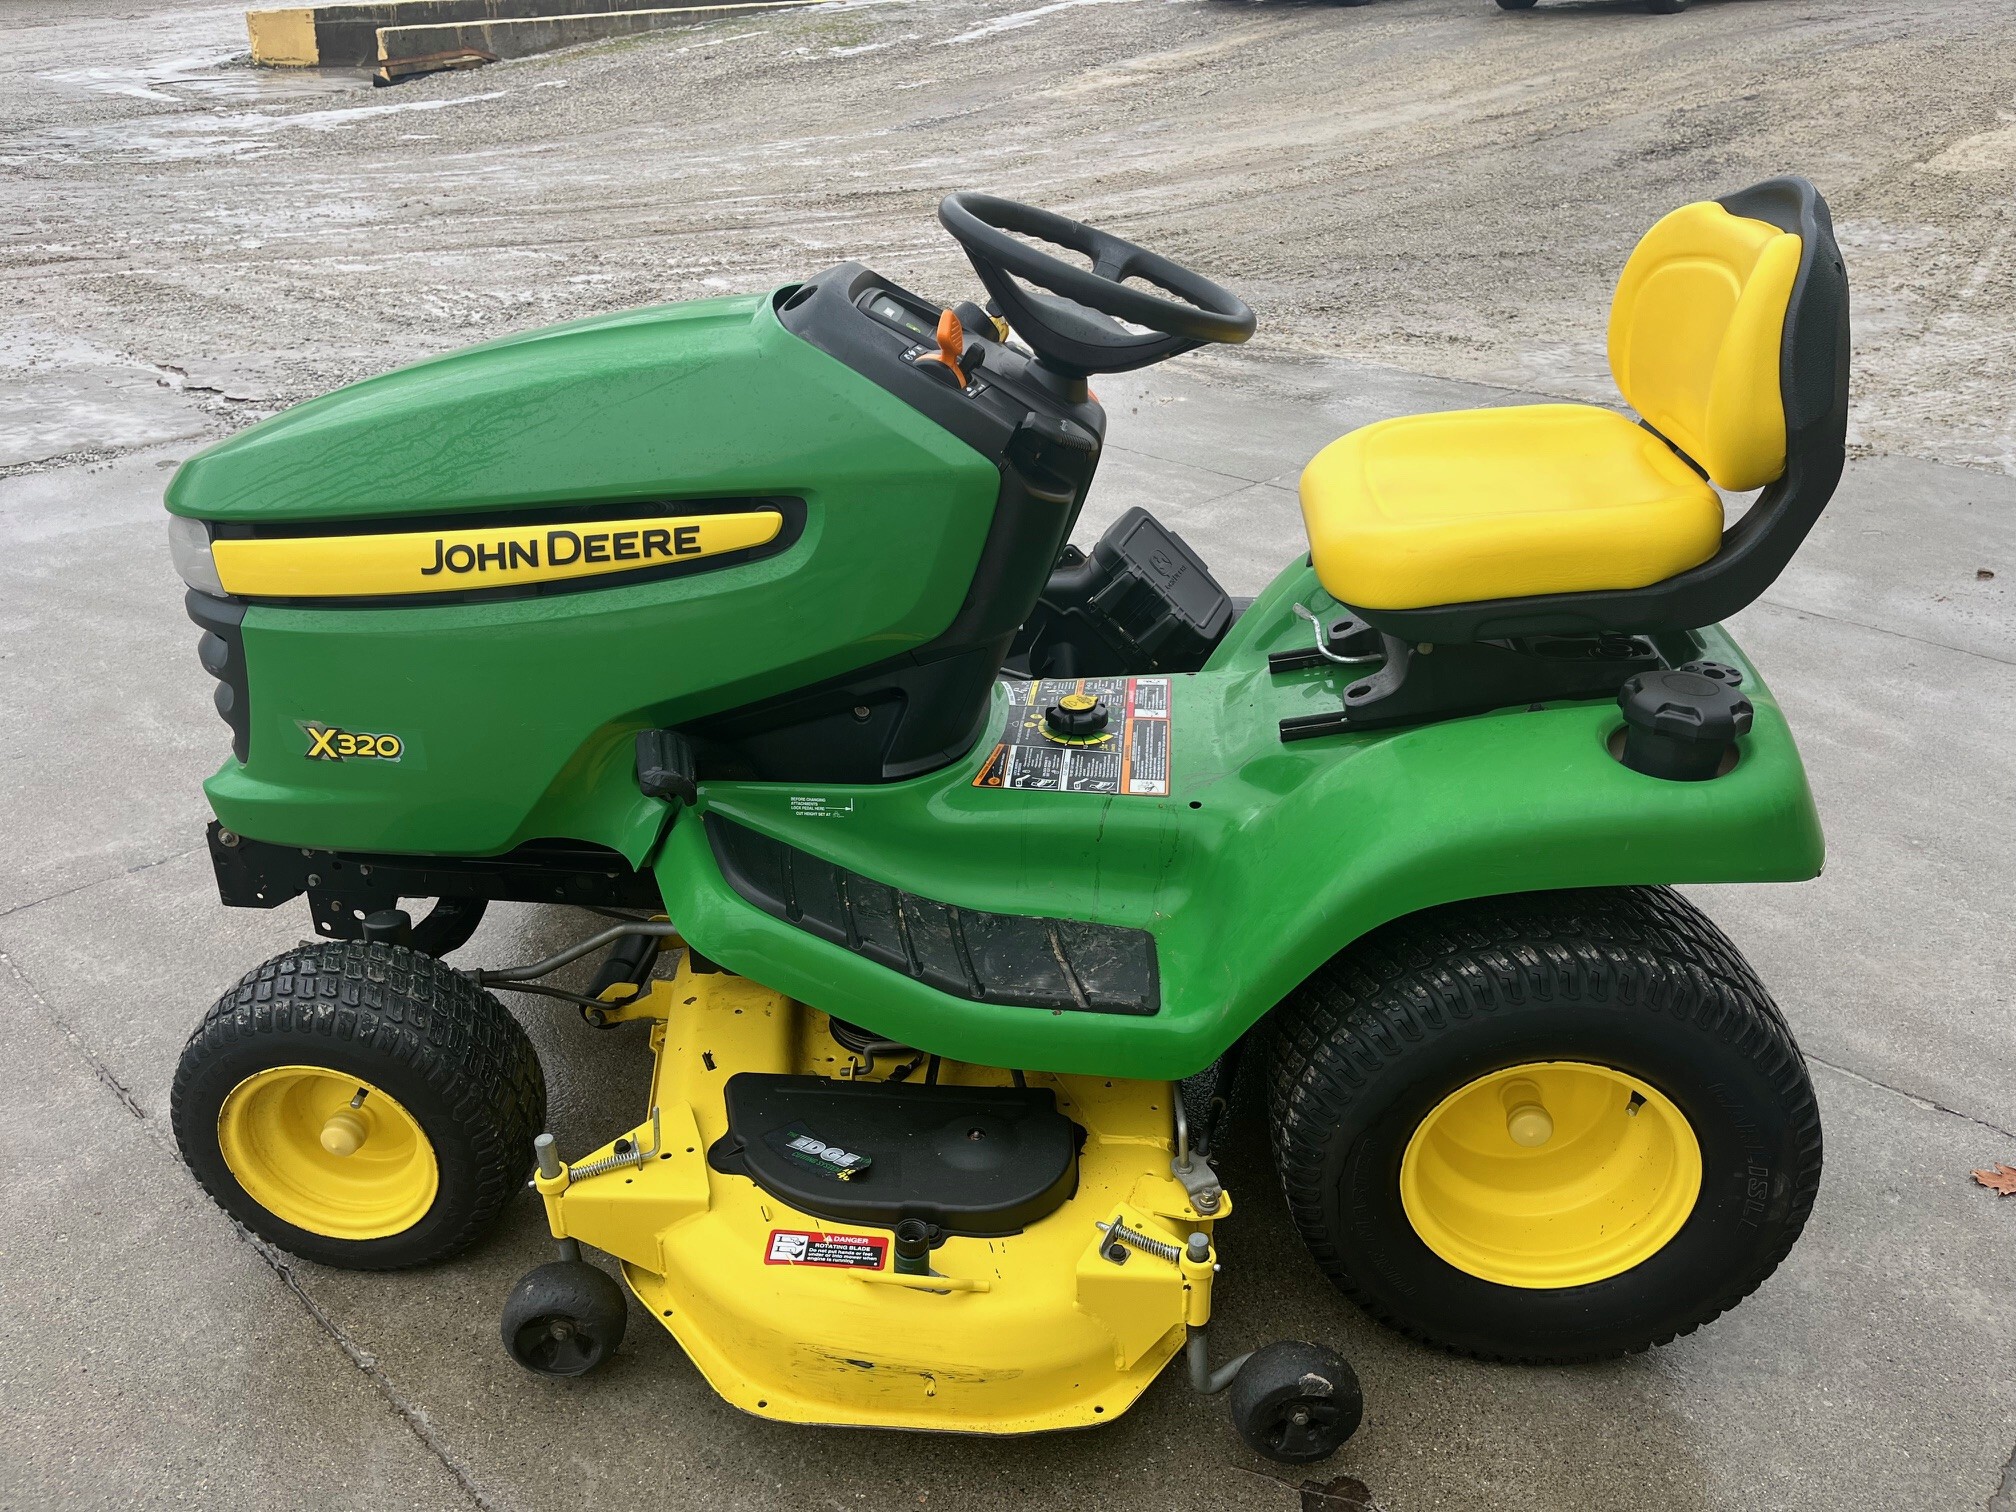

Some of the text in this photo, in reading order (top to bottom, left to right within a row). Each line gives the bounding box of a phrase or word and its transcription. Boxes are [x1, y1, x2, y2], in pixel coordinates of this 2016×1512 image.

[421, 525, 702, 576] JOHN DEERE
[305, 726, 401, 759] X320
[786, 1134, 862, 1168] EDGE
[791, 1151, 844, 1172] CUTTING SYSTEM
[834, 1236, 869, 1244] DANGER
